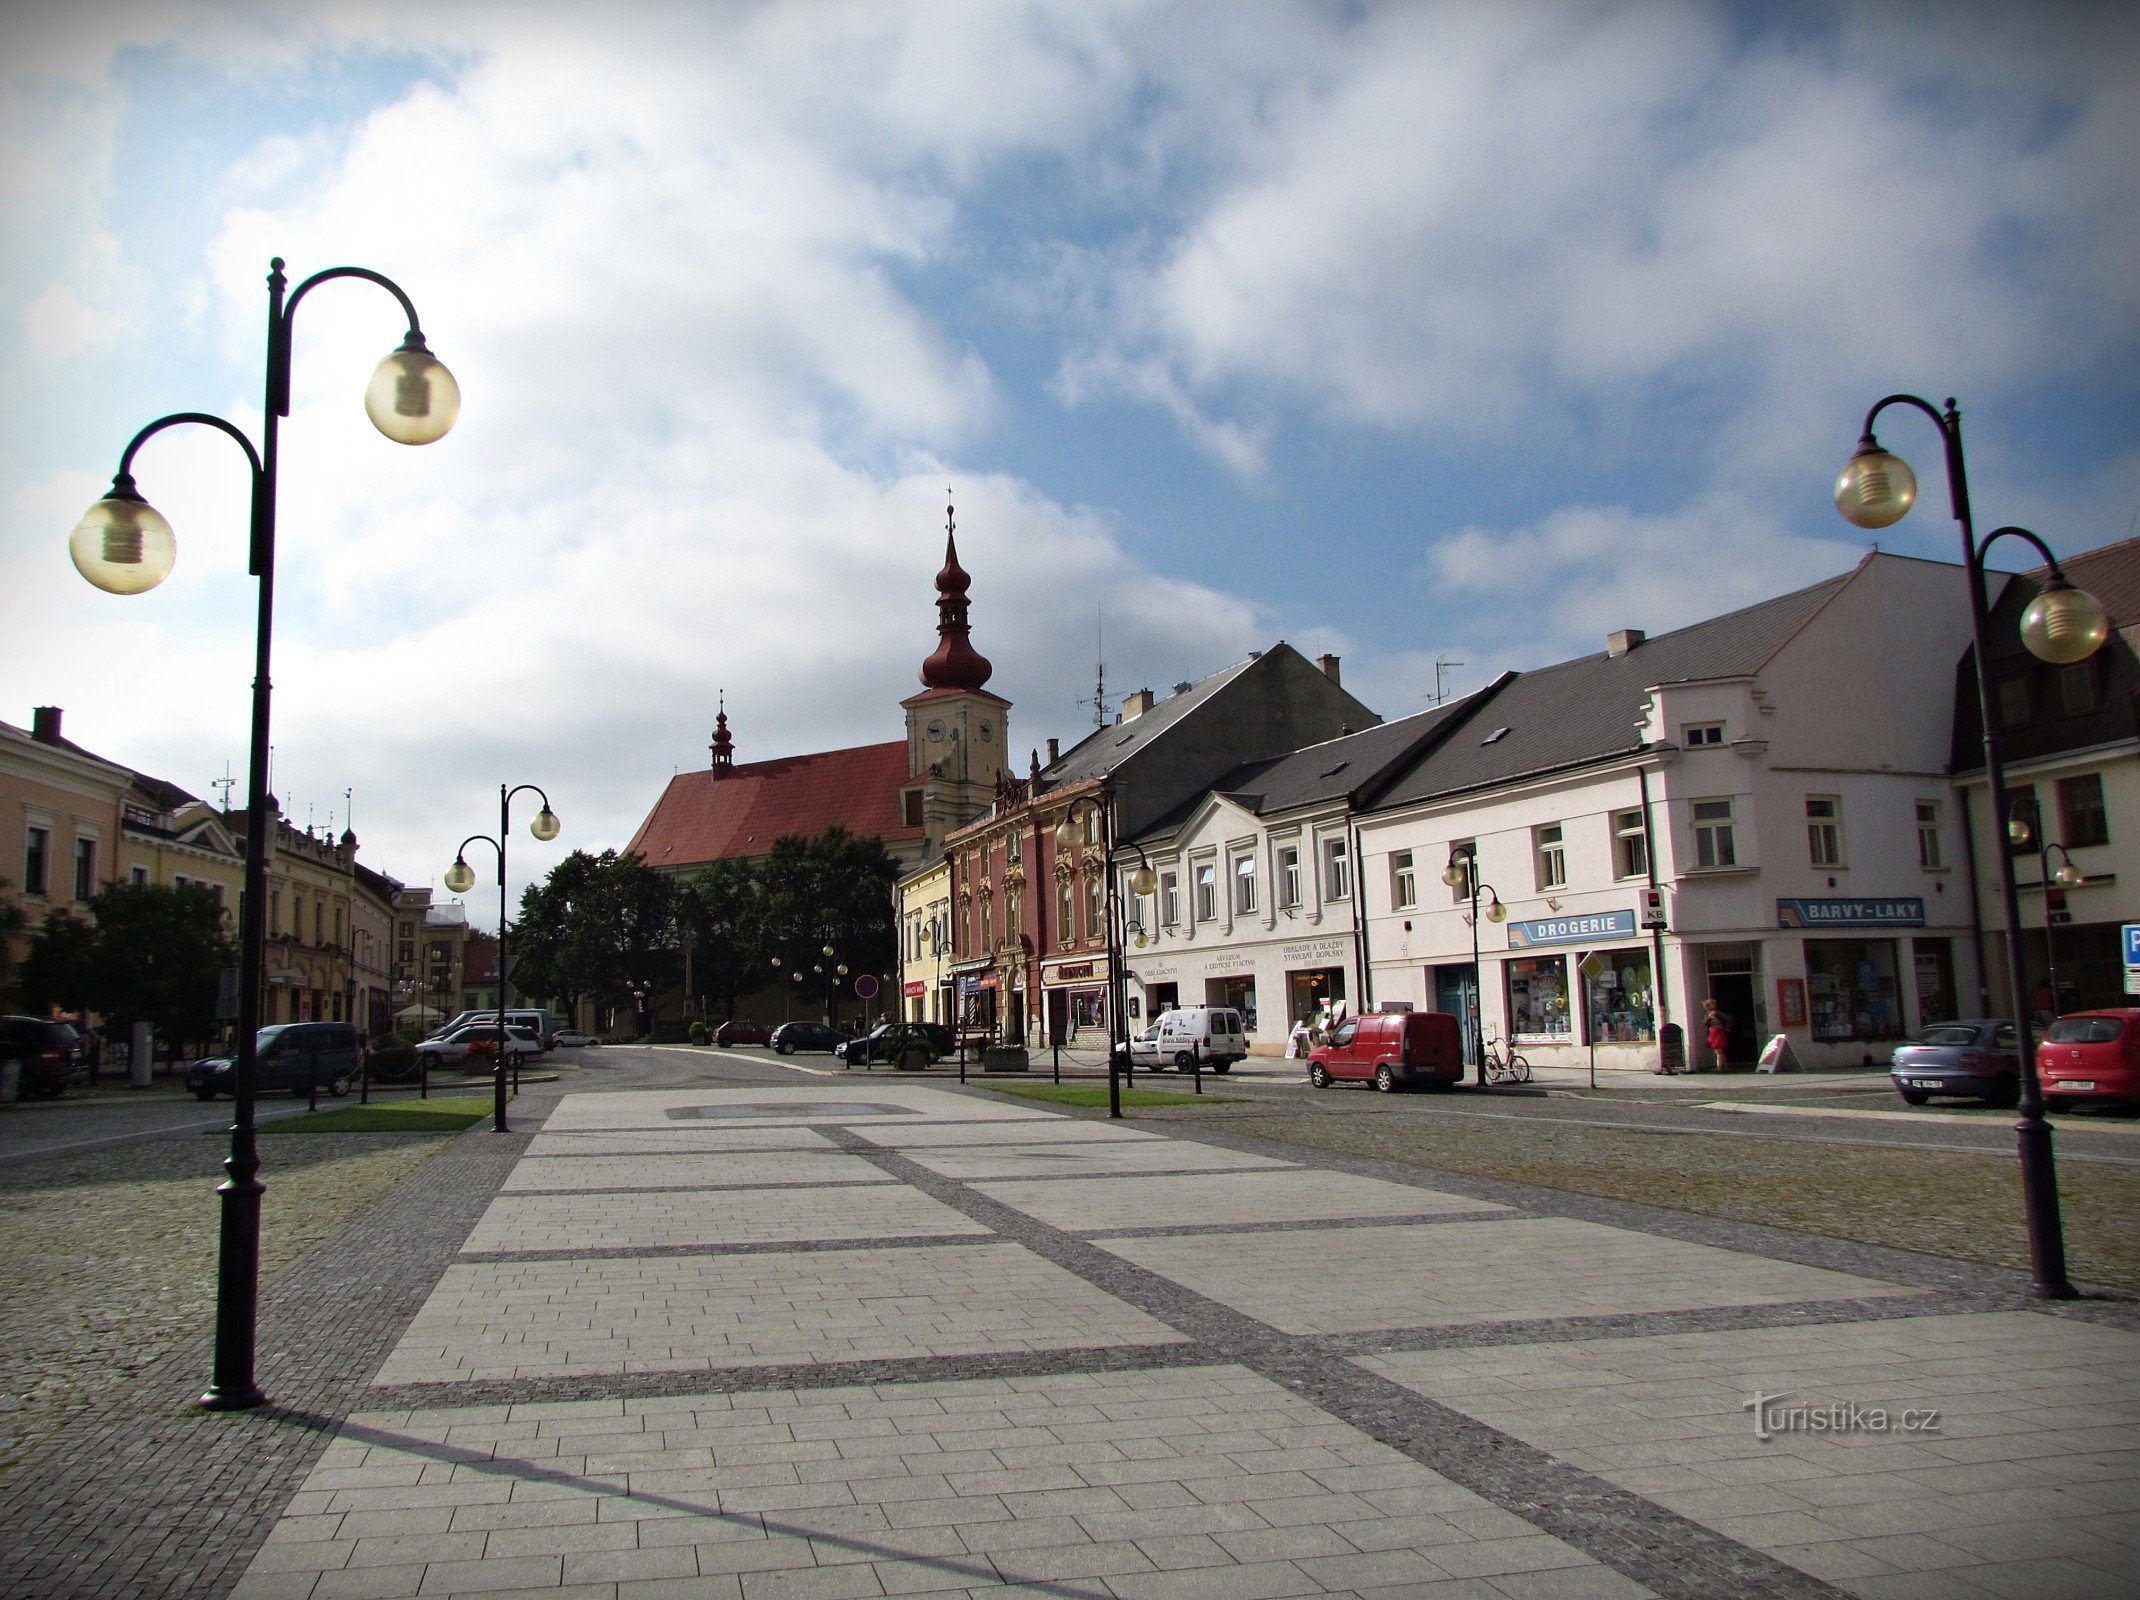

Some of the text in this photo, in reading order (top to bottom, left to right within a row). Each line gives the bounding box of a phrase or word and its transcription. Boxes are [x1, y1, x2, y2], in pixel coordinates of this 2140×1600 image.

[1647, 910, 1663, 919] KB
[1807, 904, 1917, 918] BARVY-LAKY
[1537, 916, 1617, 938] DROGERIE
[1312, 943, 1318, 951] A
